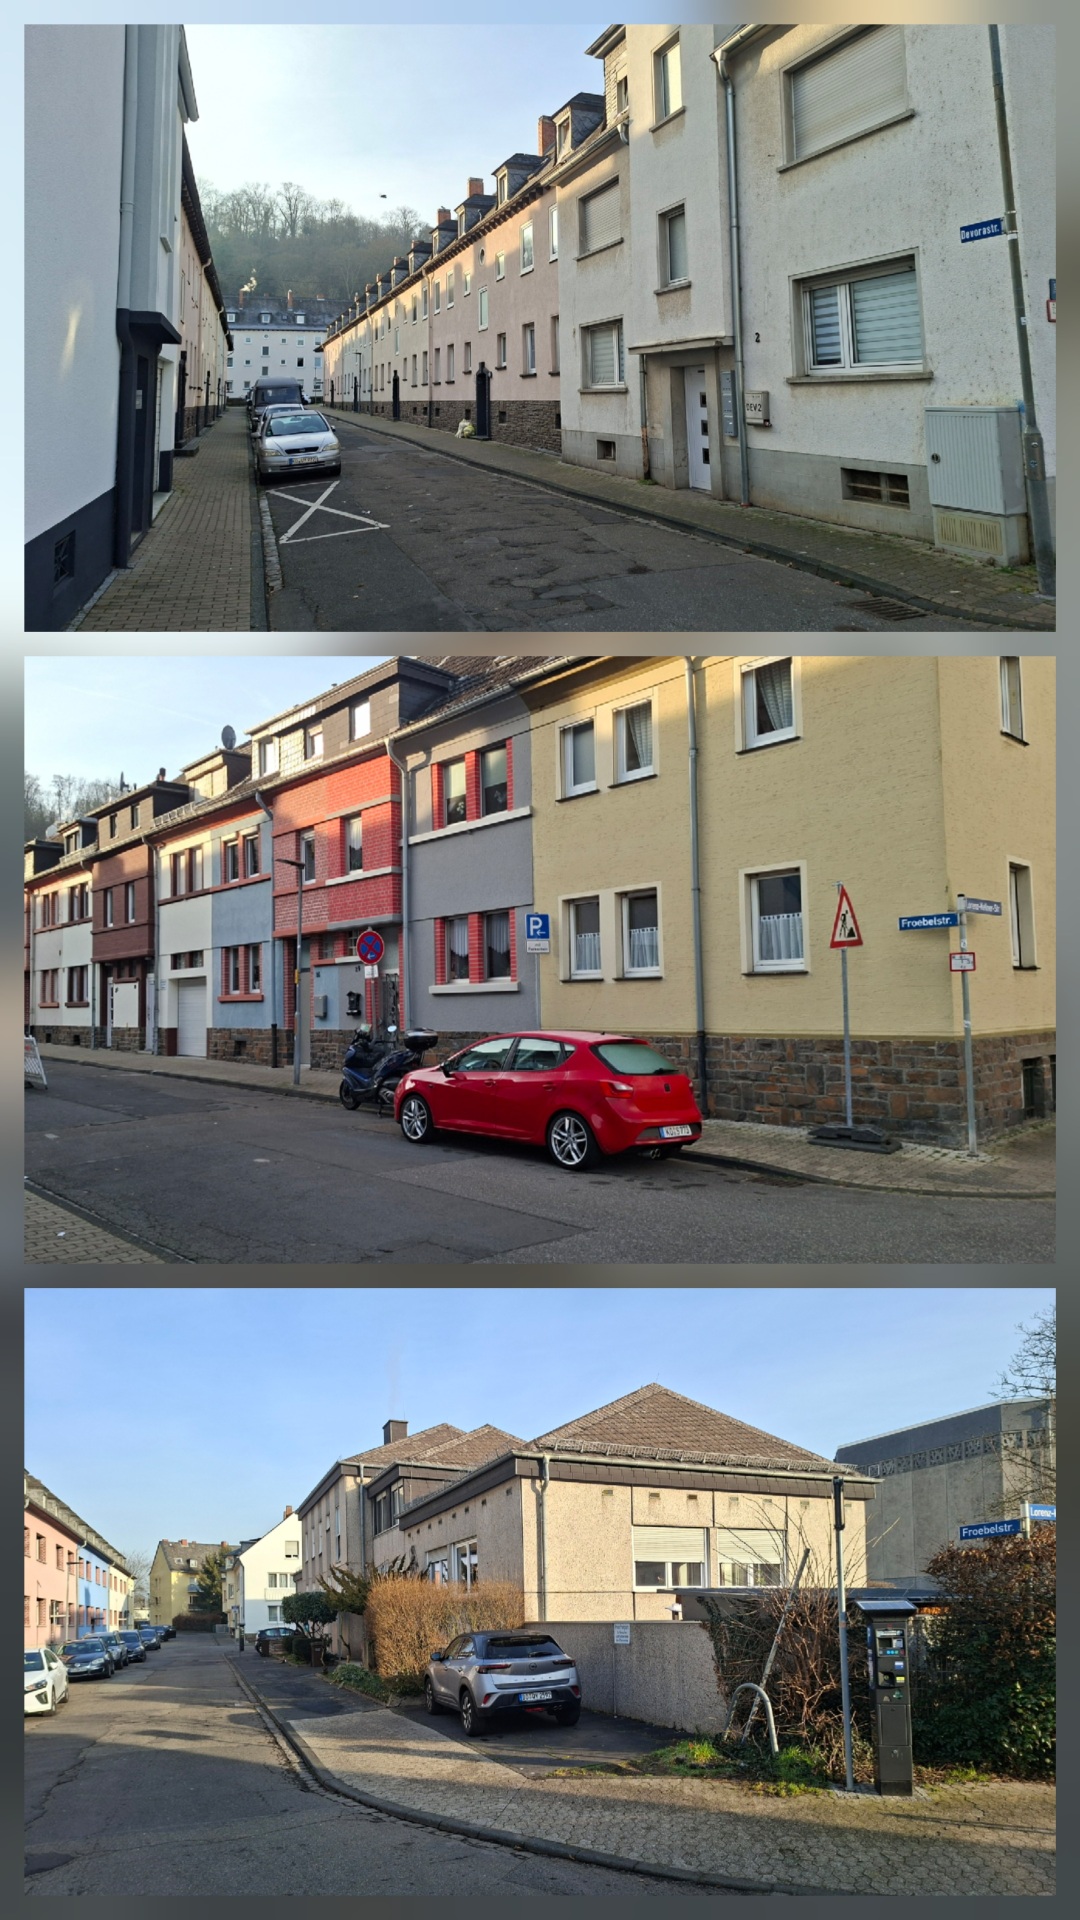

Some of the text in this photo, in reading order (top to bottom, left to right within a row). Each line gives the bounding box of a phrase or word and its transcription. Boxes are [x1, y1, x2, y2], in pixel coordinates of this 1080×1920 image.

[961, 223, 1000, 240] Devorastr.
[755, 332, 761, 343] 2
[529, 916, 543, 937] P
[901, 916, 952, 928] Froebelstr.
[962, 1523, 1014, 1537] Froebelstr.
